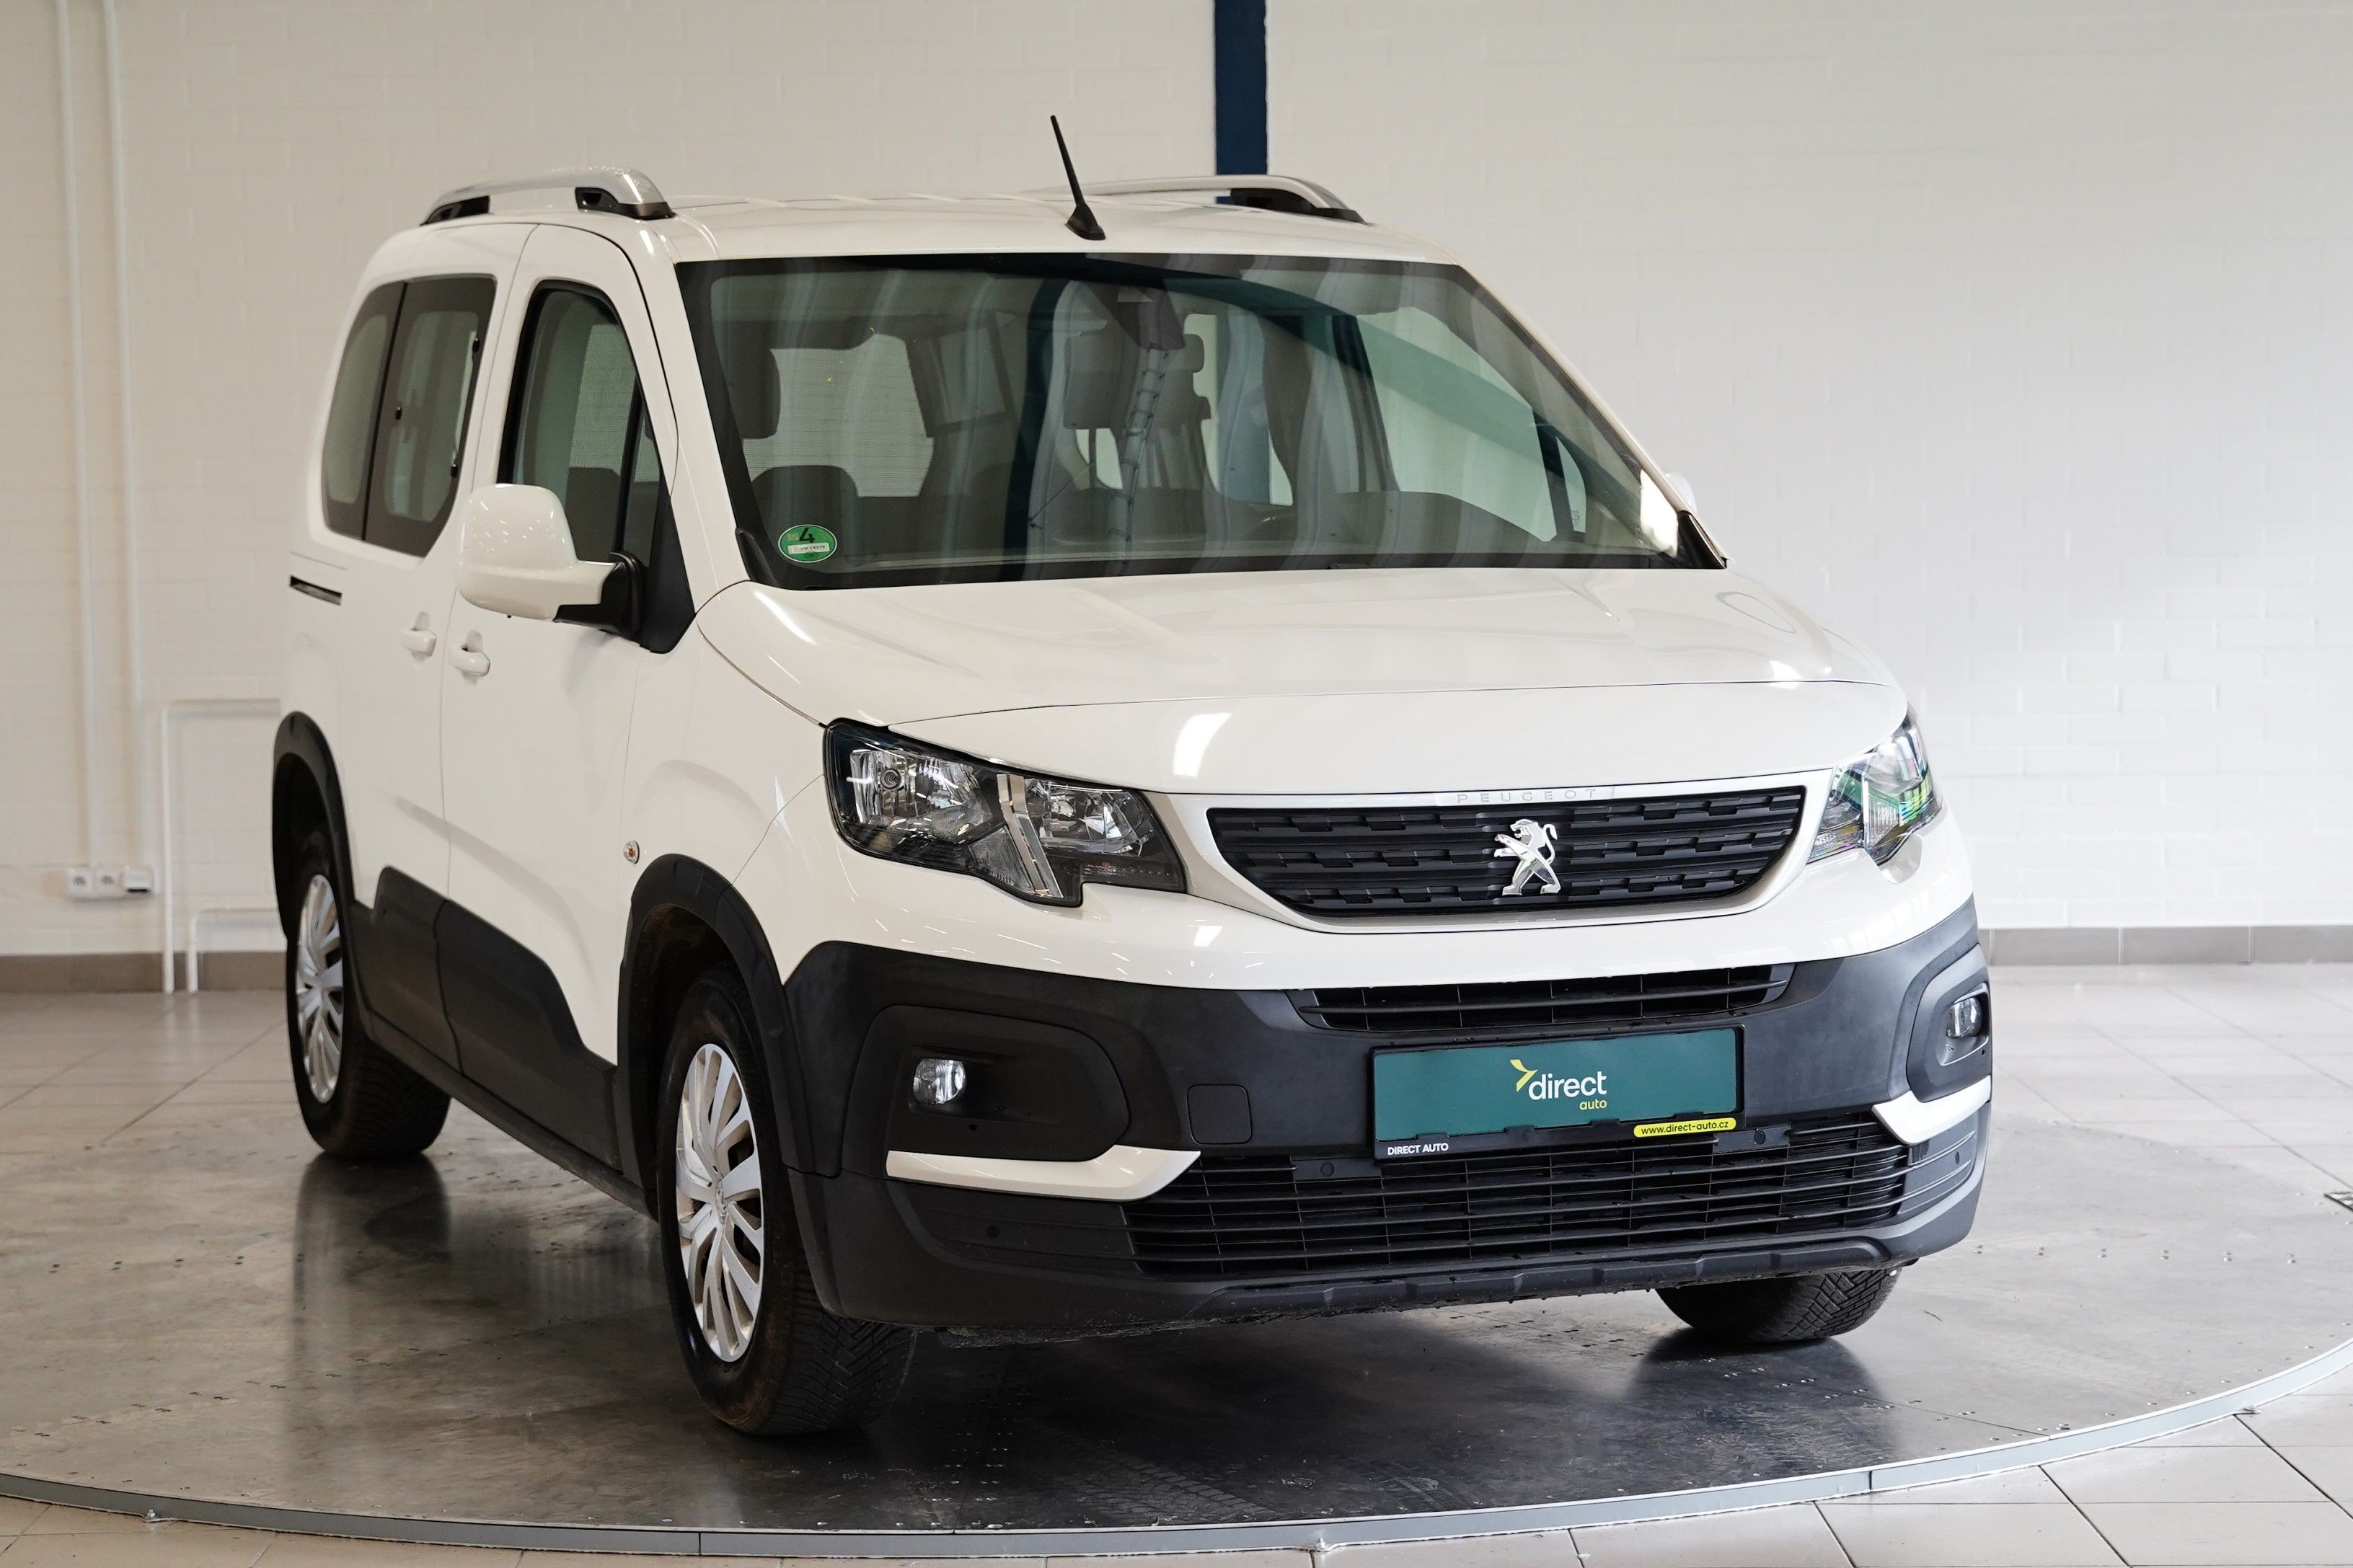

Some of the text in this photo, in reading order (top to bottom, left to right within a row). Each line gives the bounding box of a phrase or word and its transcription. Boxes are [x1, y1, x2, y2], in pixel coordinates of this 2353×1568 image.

[799, 527, 816, 543] 4
[1457, 787, 1596, 804] PEUGEOT
[1528, 1071, 1607, 1100] direct
[1579, 1099, 1607, 1110] auto
[1641, 1121, 1729, 1135] www.direct-auto.cz
[1387, 1143, 1449, 1156] DIRECT AUTO
